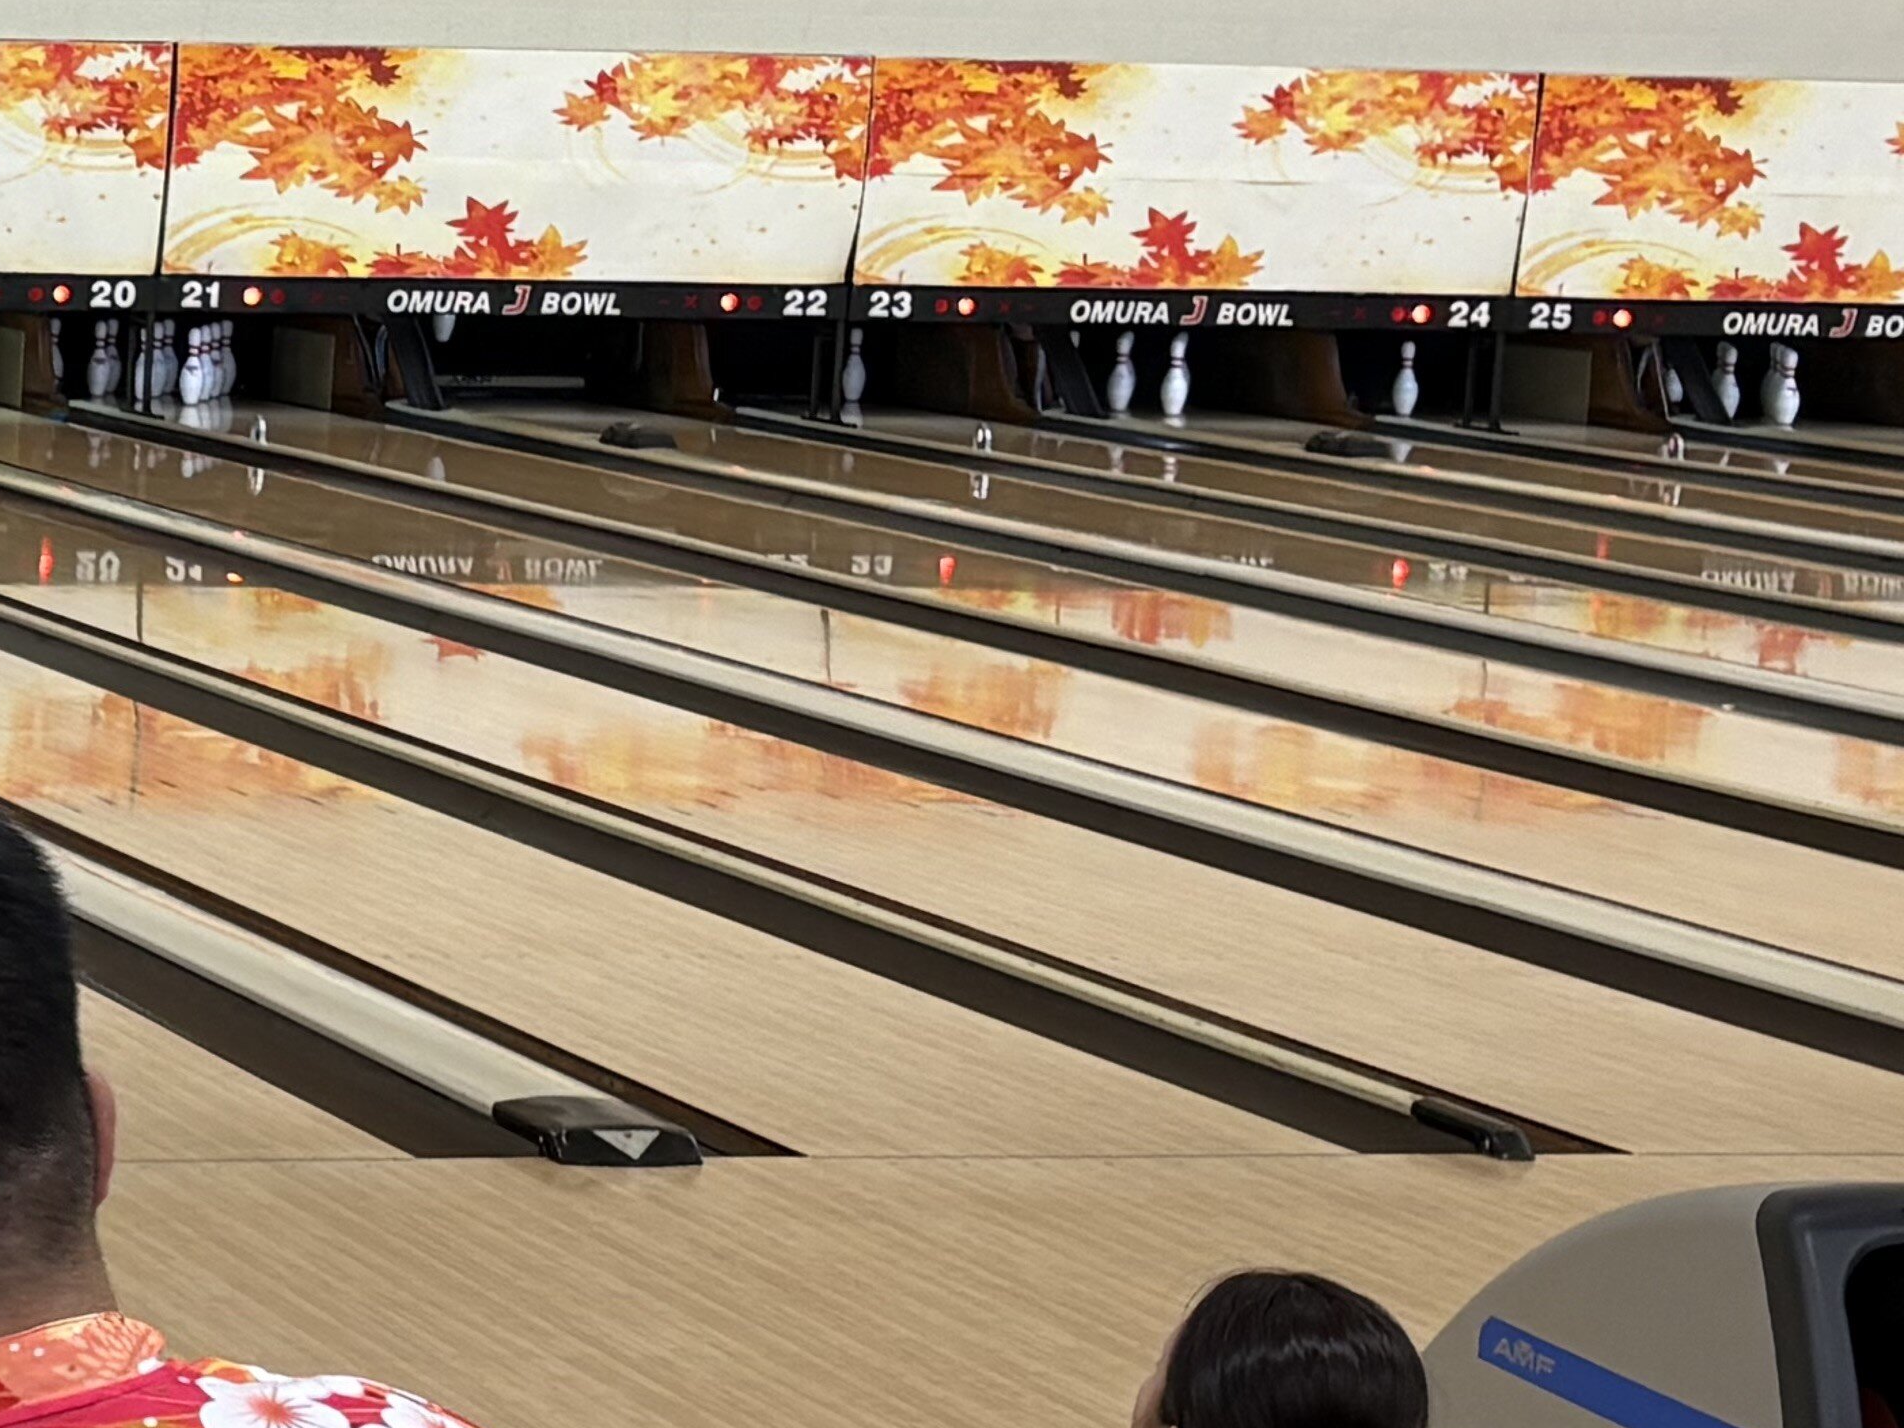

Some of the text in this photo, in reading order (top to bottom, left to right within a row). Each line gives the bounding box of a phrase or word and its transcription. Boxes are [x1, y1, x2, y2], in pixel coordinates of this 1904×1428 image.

[89, 279, 138, 310] 20
[181, 279, 221, 310] 21
[387, 289, 491, 315] OMURA
[540, 291, 622, 317] BOWL
[783, 289, 828, 318] 22
[868, 291, 914, 320] 23
[1069, 299, 1171, 325] OMURA
[1216, 302, 1296, 328] BOWL
[1447, 300, 1491, 328] 24
[1528, 303, 1573, 330] 25
[1723, 312, 1819, 336] OMURA
